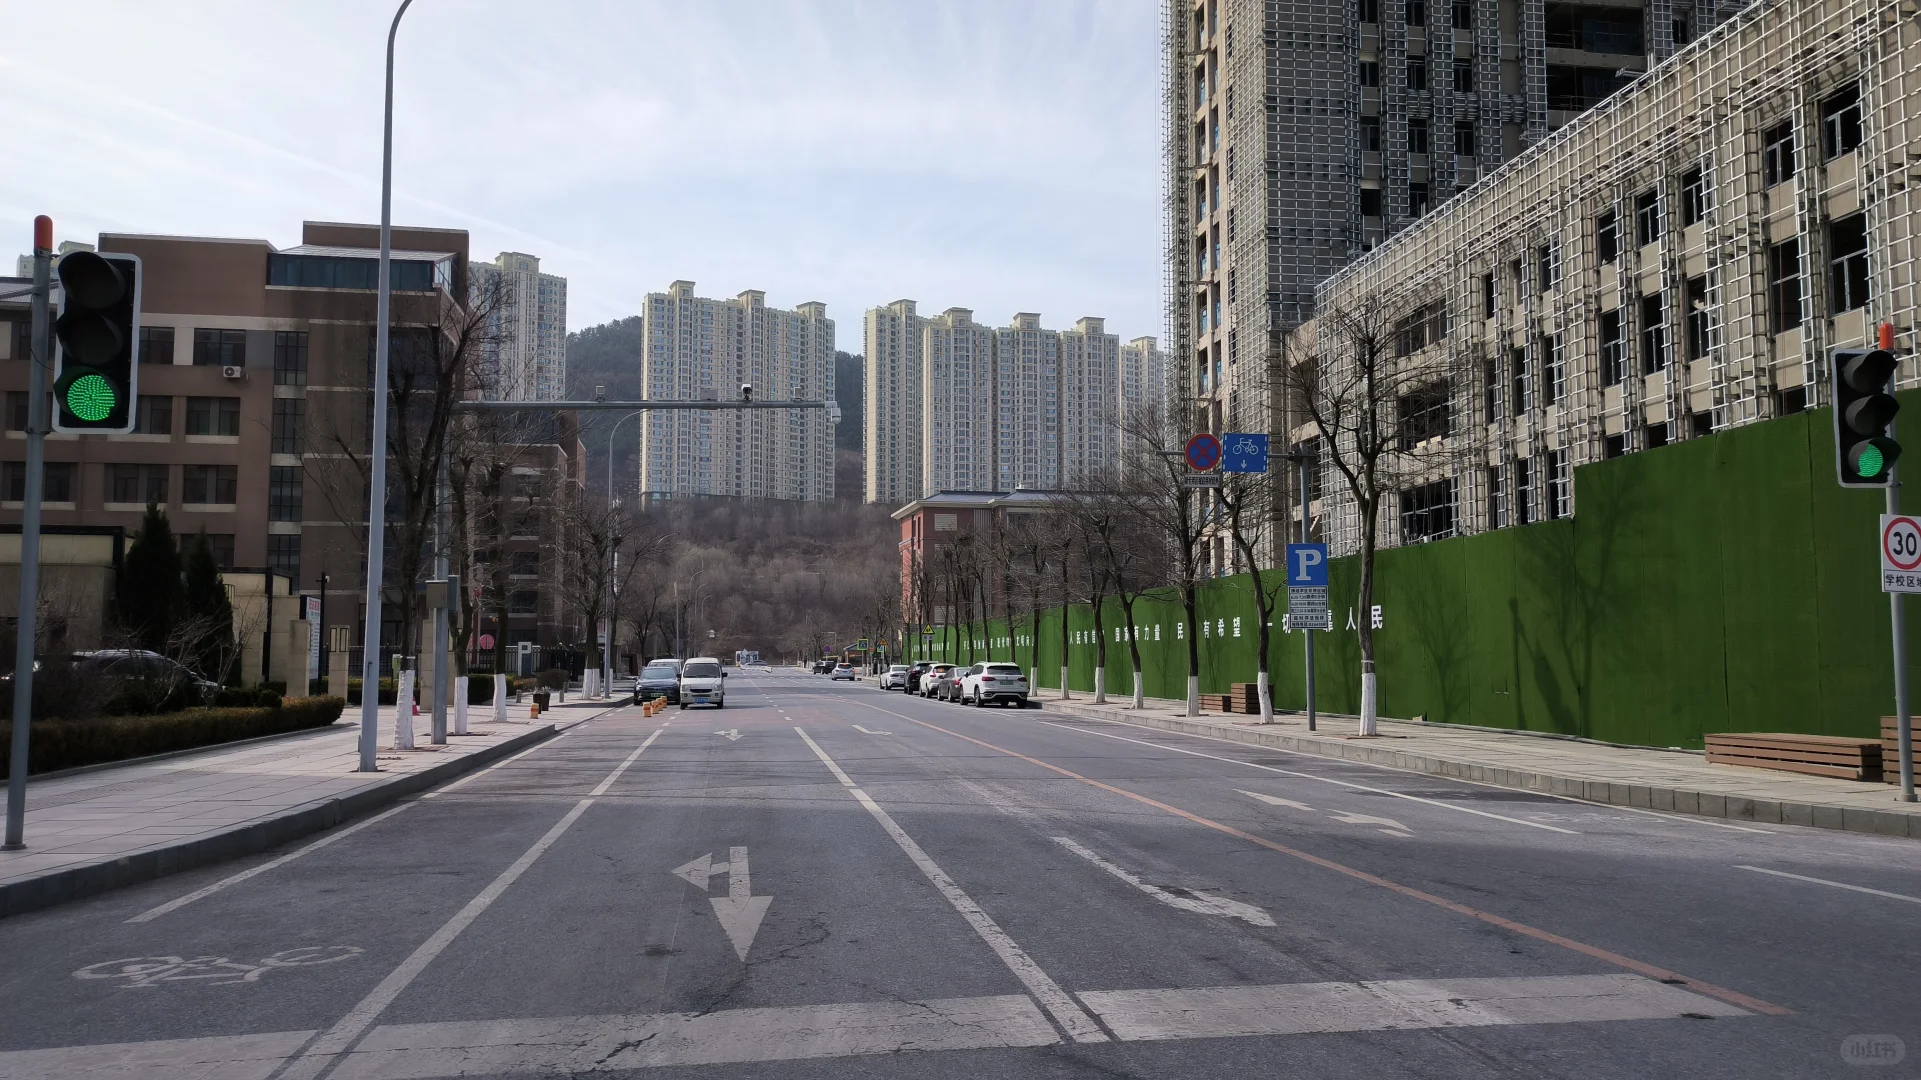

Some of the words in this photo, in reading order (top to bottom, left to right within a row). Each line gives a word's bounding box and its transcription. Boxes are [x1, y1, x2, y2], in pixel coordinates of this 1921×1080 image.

[1893, 532, 1917, 556] 30
[1295, 550, 1322, 581] P
[1069, 629, 1104, 644] 人民有信
[1177, 616, 1241, 639] 民有希望
